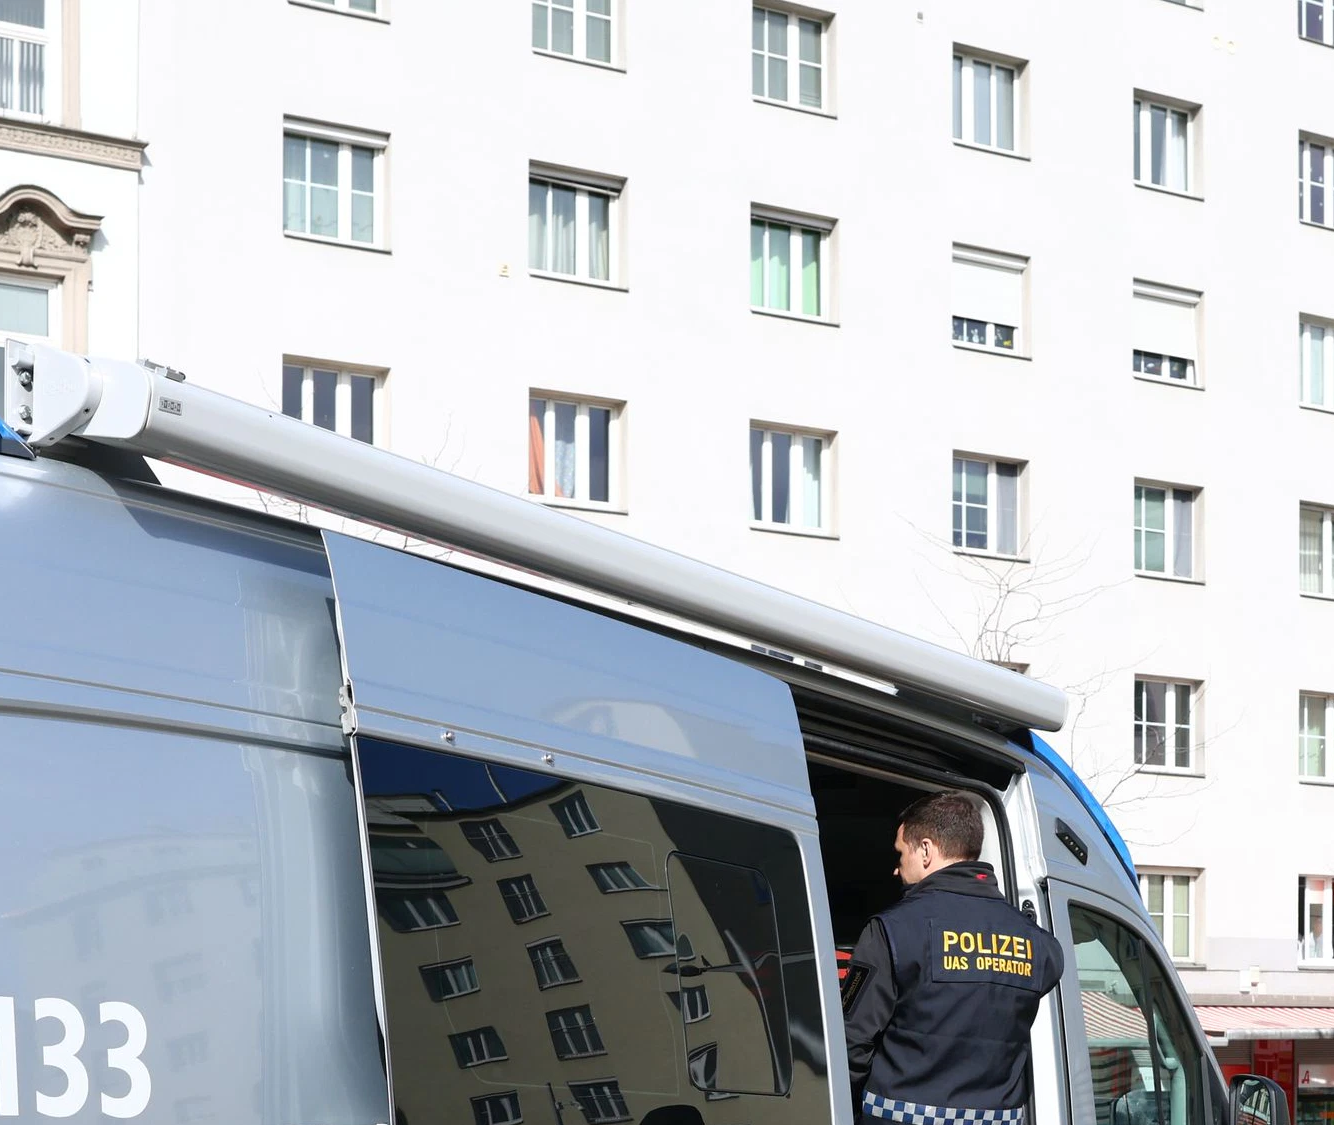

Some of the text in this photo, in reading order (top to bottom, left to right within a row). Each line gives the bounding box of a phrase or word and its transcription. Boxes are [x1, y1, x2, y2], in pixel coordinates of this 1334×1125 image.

[943, 931, 1032, 960] POLIZEI
[943, 956, 1032, 977] UAS OPERATOR
